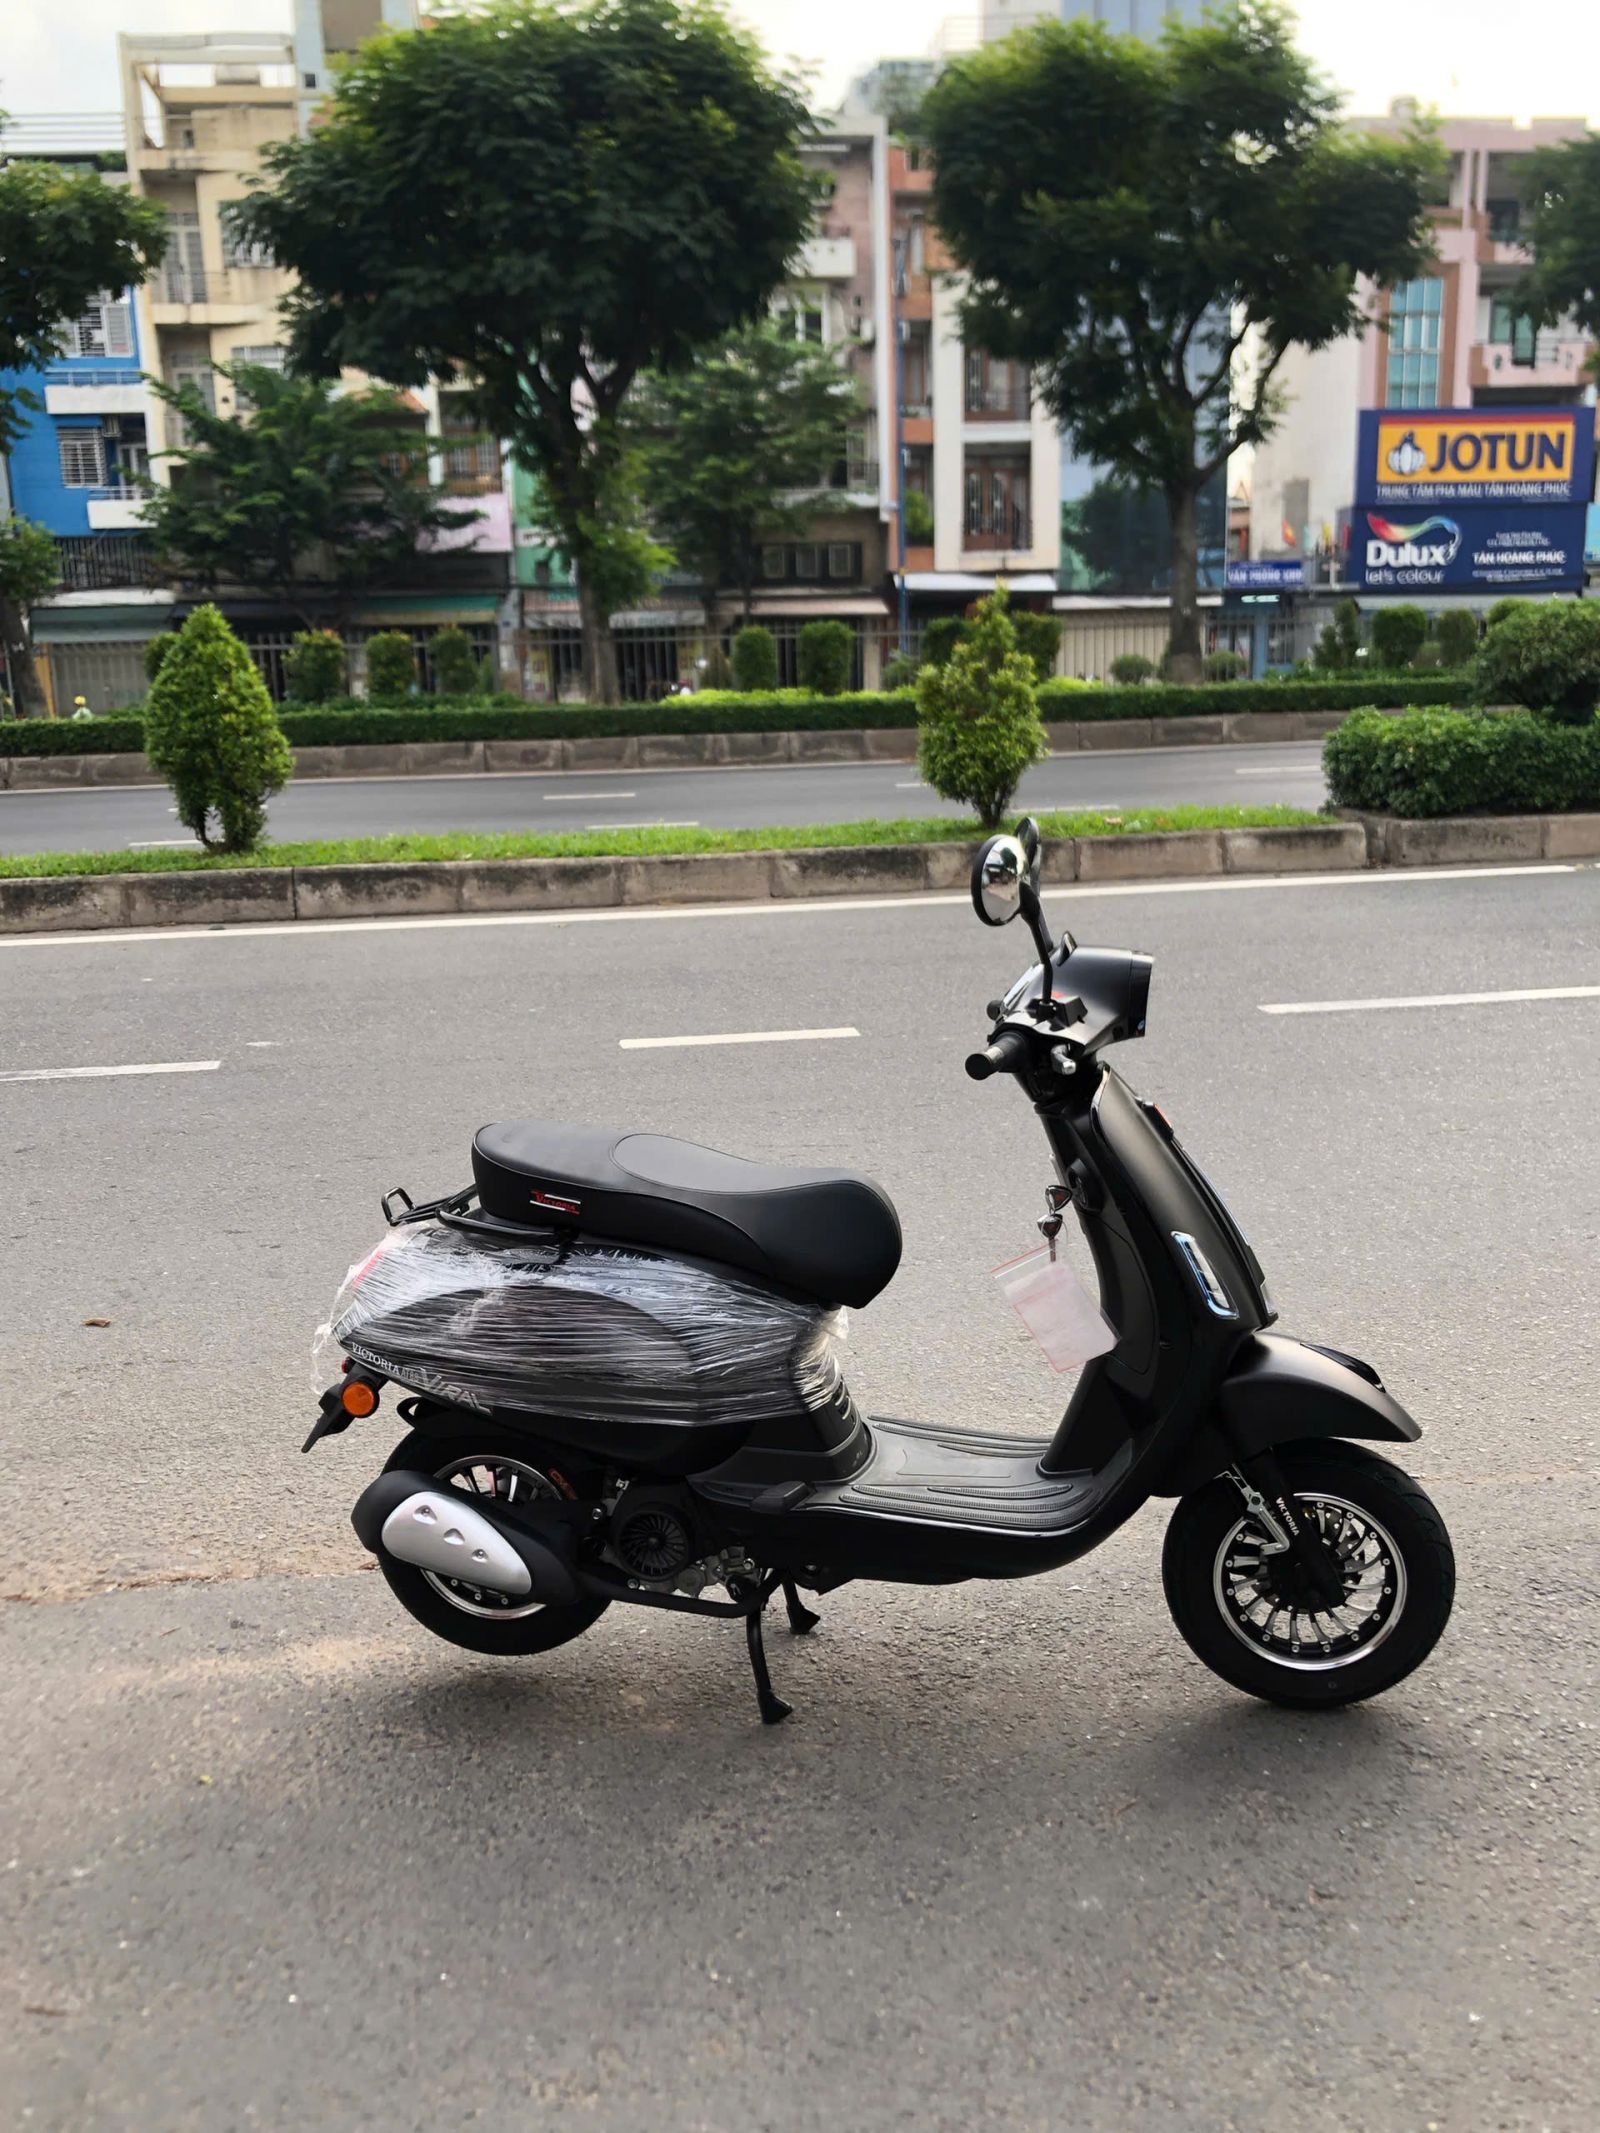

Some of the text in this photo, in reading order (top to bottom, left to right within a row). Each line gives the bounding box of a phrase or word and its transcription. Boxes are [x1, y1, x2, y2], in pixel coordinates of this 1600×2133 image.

[1429, 431, 1566, 473] JOTUN
[1376, 484, 1408, 498] TRUNG
[1435, 483, 1456, 497] PHA
[1366, 540, 1447, 568] Dulux
[1365, 568, 1444, 585] let's colour
[351, 1341, 401, 1376] VICTORIA
[1275, 1496, 1300, 1536] VICTORIA
